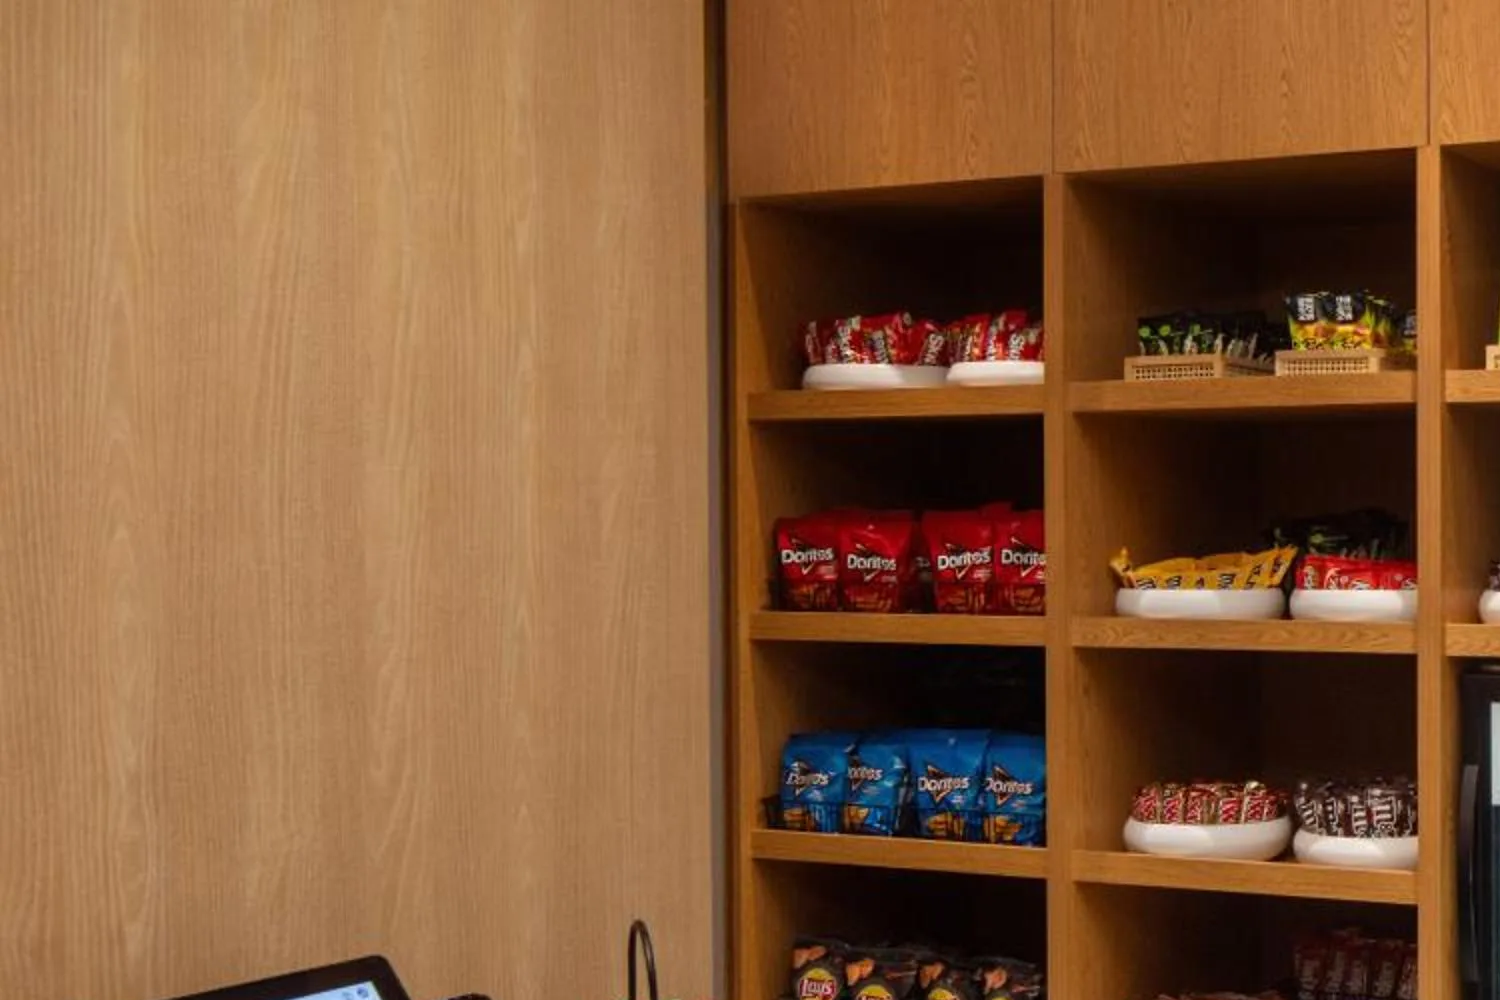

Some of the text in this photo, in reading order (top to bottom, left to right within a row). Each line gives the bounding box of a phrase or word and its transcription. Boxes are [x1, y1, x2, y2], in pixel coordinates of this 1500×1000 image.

[781, 547, 834, 565] Doritos
[847, 553, 897, 572] Doritos
[937, 546, 991, 571] Doritos
[1001, 549, 1047, 566] Dorito
[918, 775, 970, 792] Doritos
[801, 978, 836, 995] Lay's
